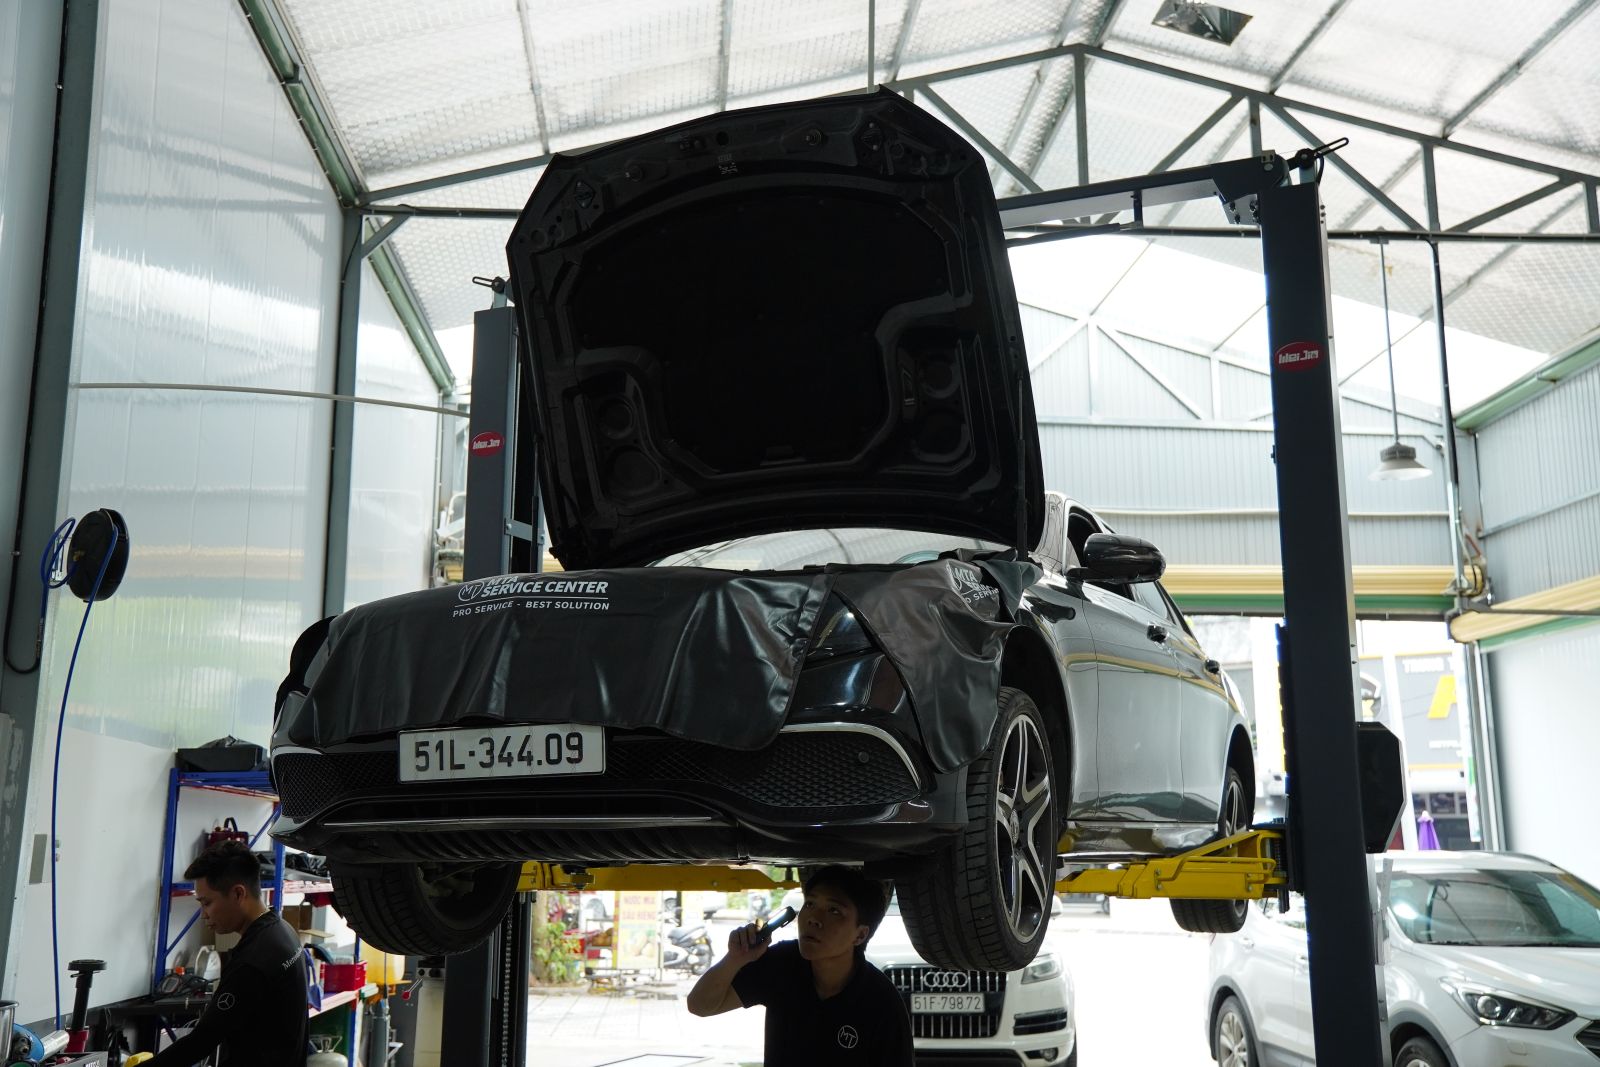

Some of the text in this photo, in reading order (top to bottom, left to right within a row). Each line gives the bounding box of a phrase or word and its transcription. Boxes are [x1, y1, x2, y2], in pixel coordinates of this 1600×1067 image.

[481, 581, 609, 597] SERVICE CENTER
[452, 607, 472, 618] PRO
[475, 600, 513, 614] SERVICE
[525, 601, 552, 609] BEST
[554, 601, 610, 611] SOLUTION
[415, 732, 584, 772] 51L-344.09
